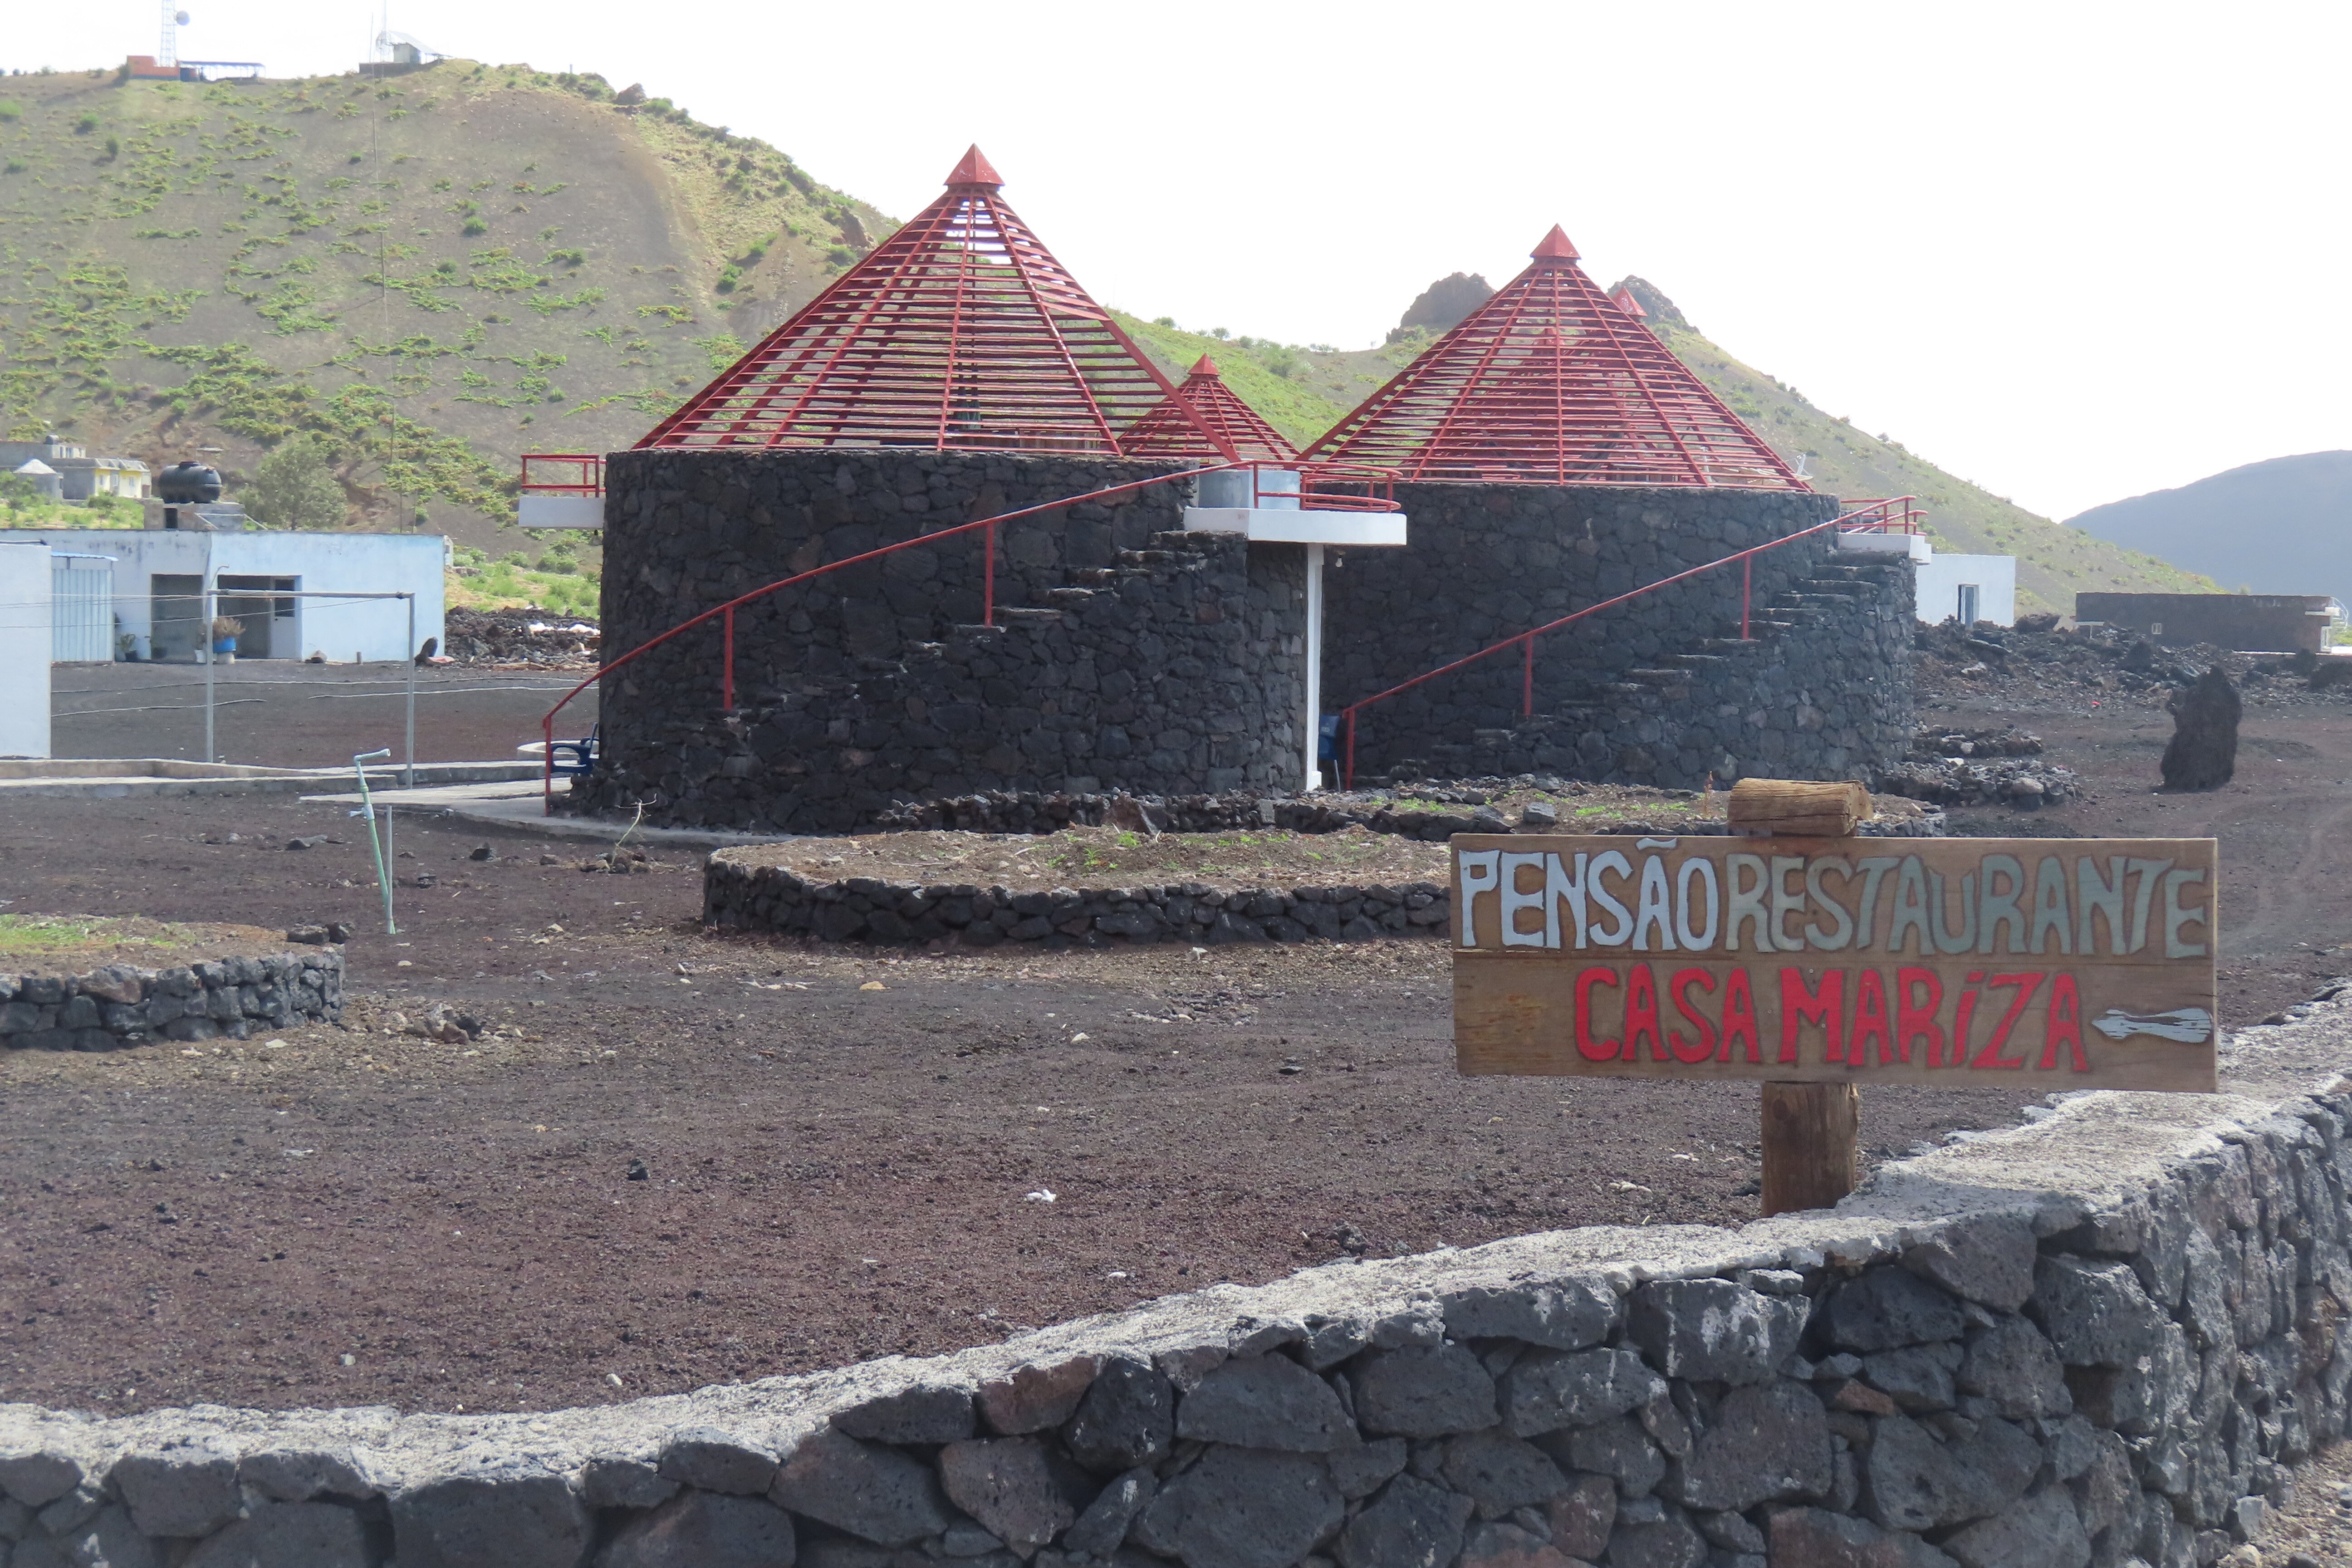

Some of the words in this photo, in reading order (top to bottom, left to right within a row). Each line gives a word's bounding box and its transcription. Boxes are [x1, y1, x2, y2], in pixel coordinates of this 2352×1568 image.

[1459, 838, 1718, 951] PENSÃO
[1726, 855, 2207, 958] RESTAURANTE
[1575, 964, 1760, 1063] CASA
